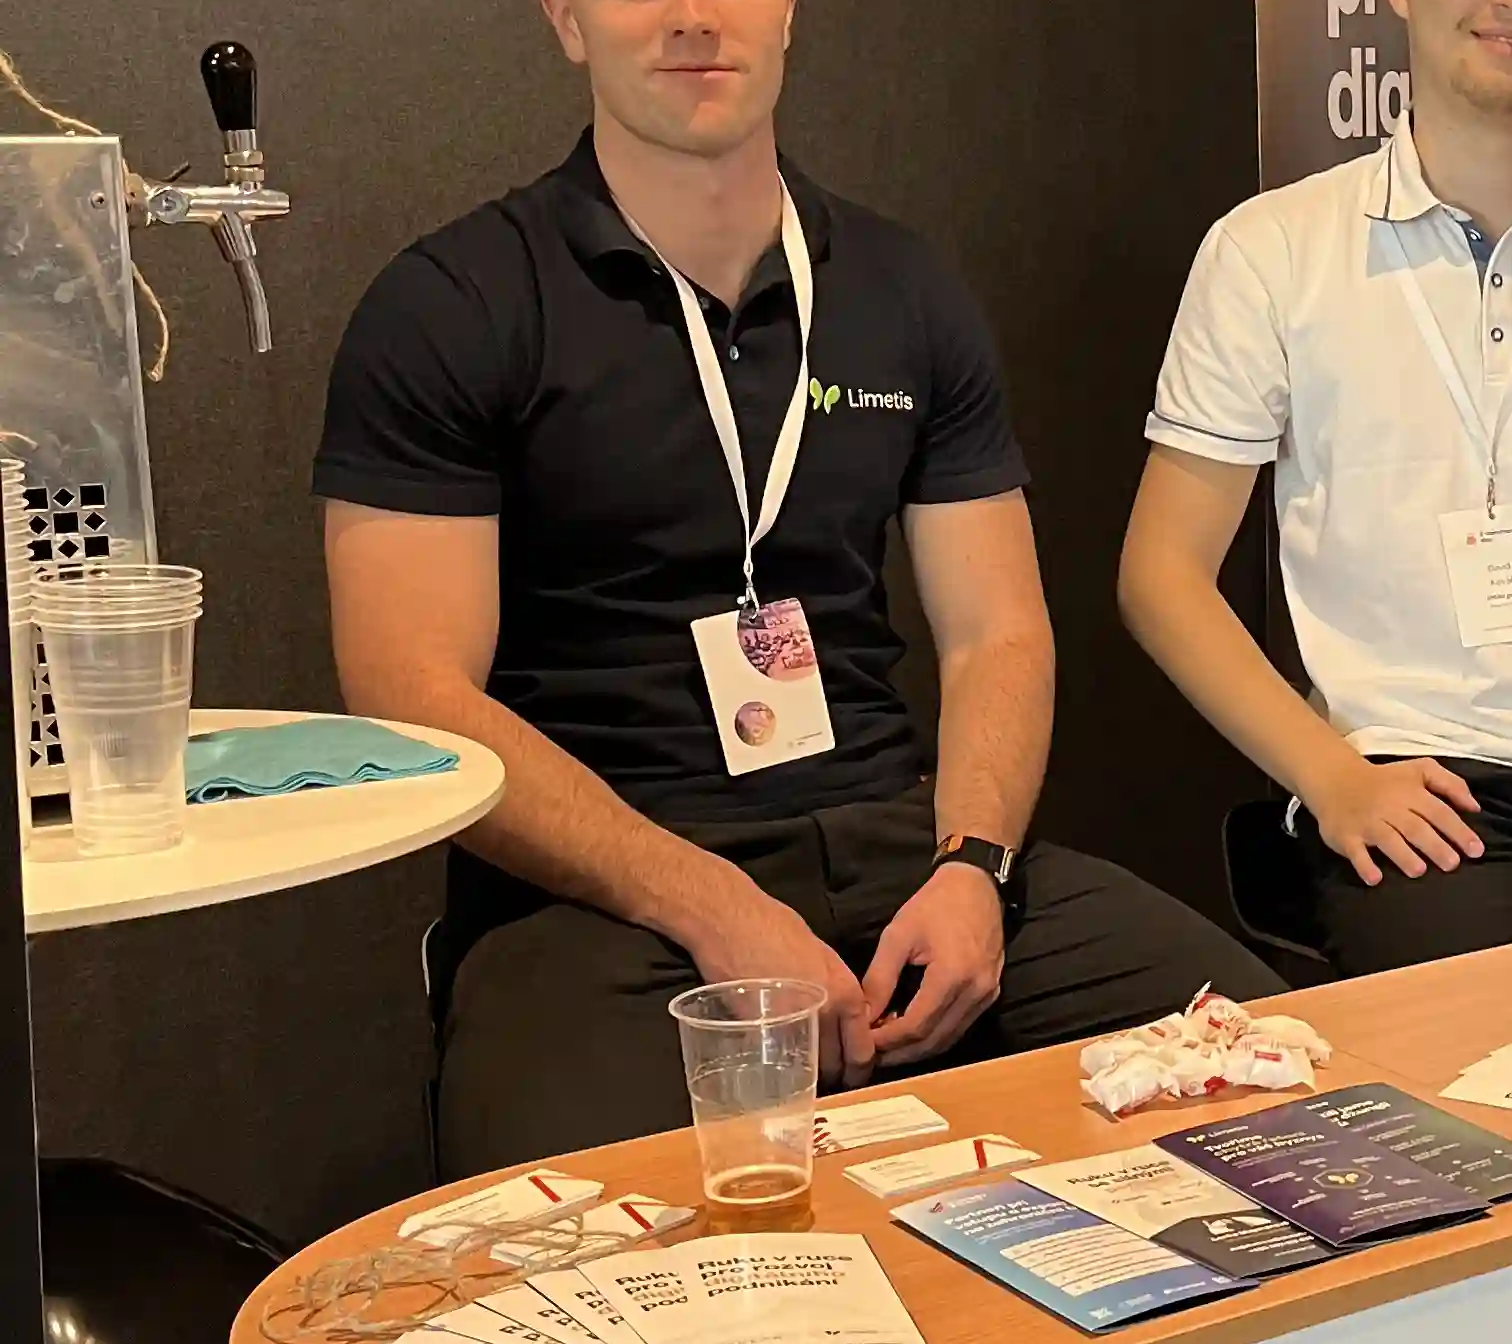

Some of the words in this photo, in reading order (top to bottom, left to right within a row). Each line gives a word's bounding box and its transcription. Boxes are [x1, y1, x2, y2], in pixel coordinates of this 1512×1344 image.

[847, 388, 914, 411] Limetis
[698, 1256, 766, 1270] Ruku
[701, 1267, 745, 1280] pro
[752, 1262, 833, 1272] rozvoj
[708, 1279, 838, 1298] podnikání
